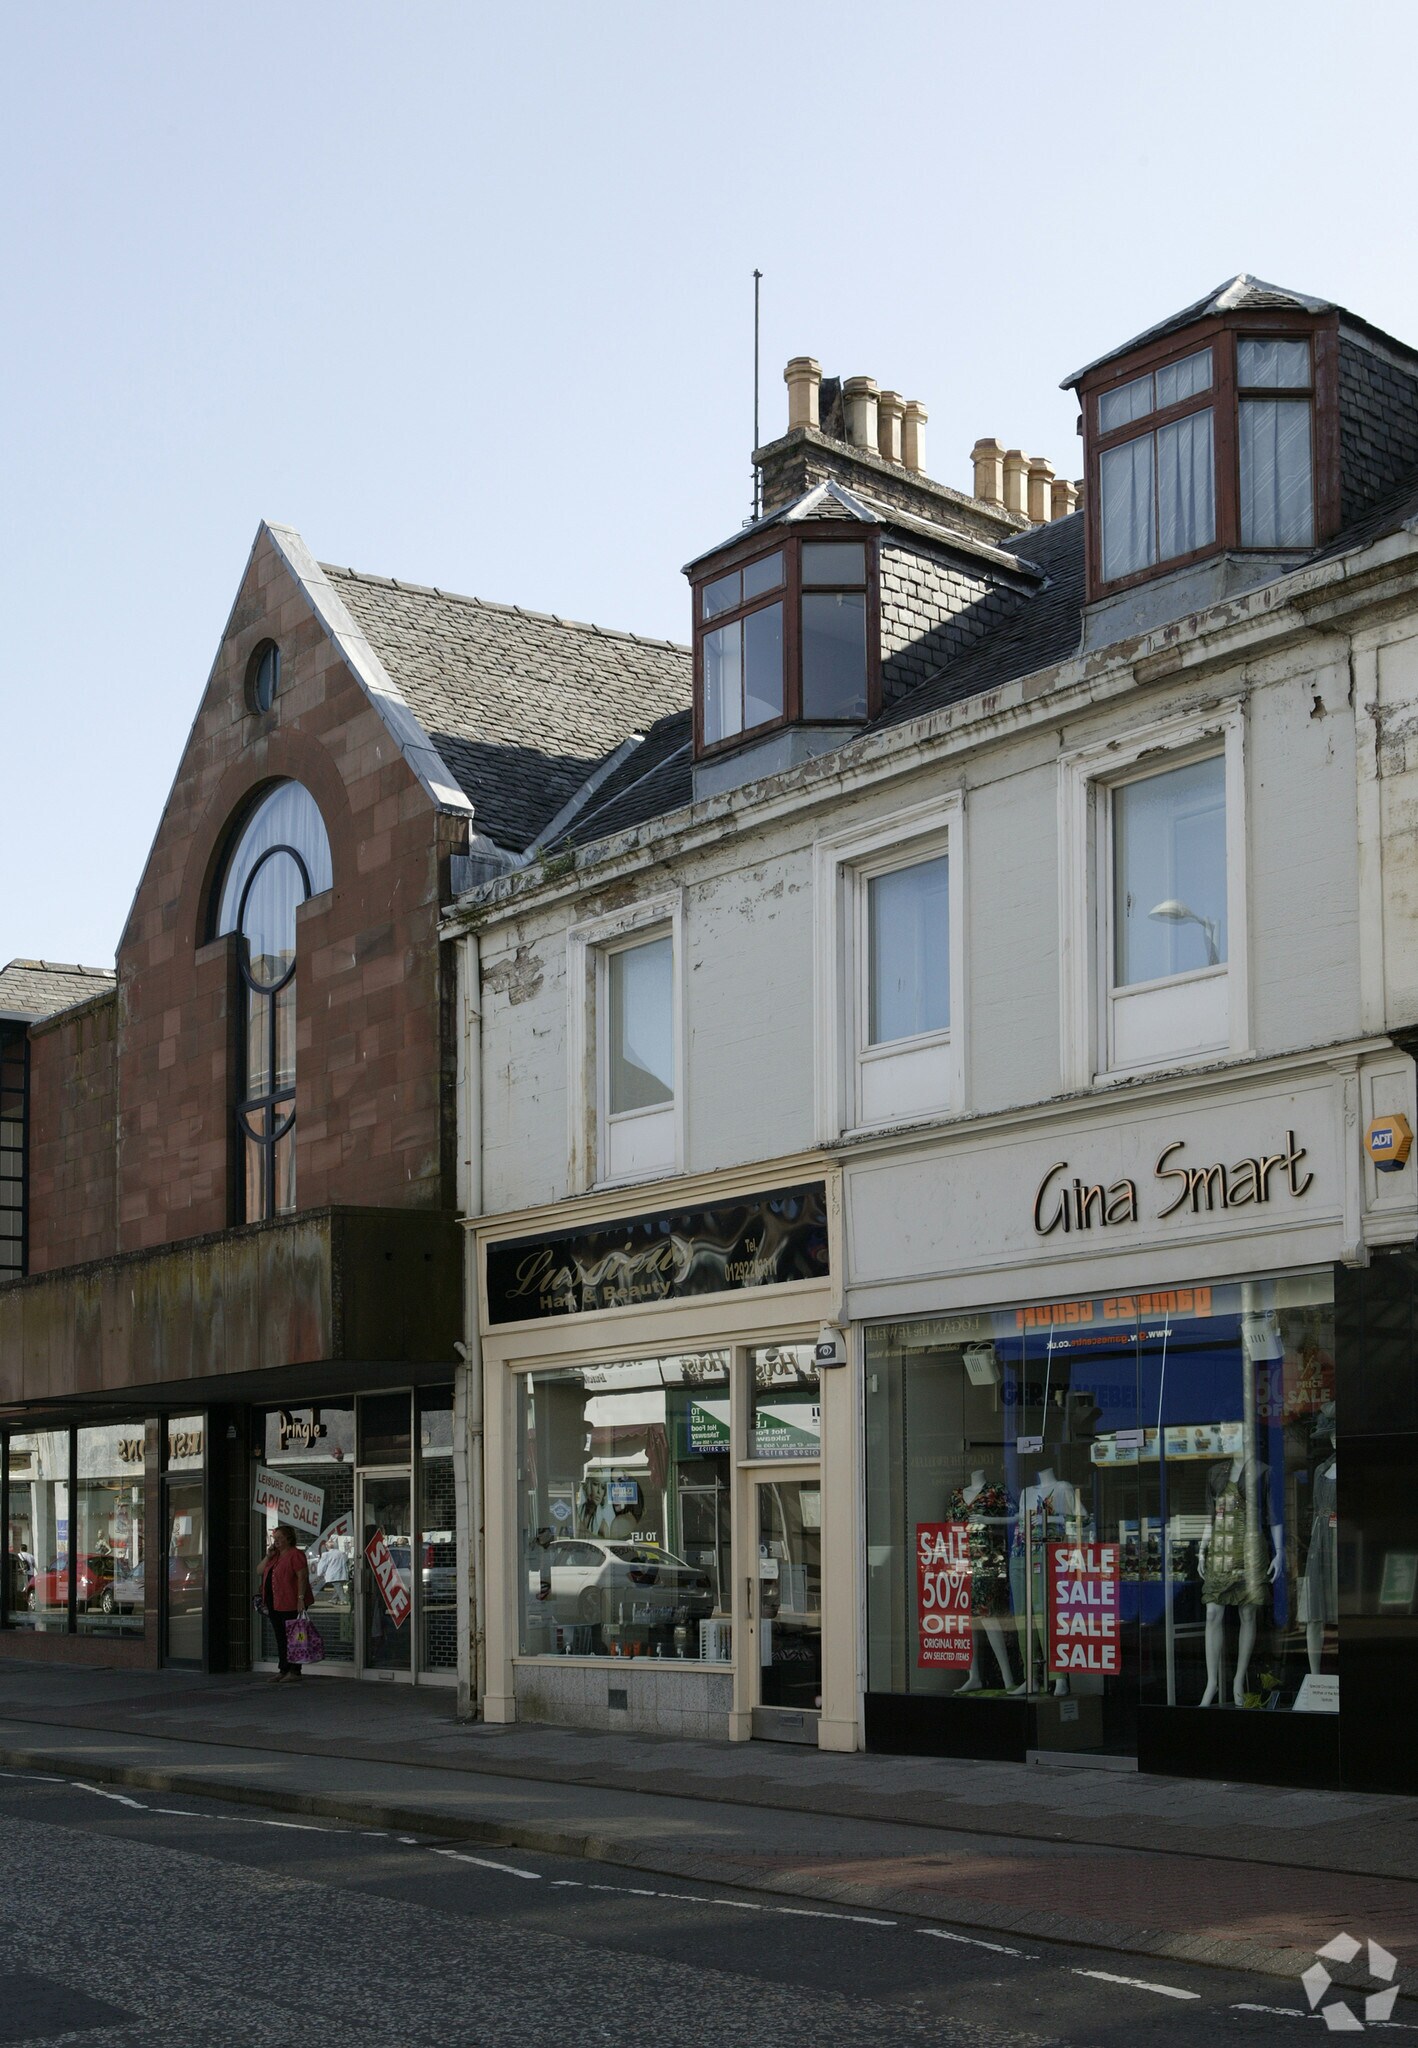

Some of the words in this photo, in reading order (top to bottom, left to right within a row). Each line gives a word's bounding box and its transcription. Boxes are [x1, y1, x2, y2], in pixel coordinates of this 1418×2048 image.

[1372, 1132, 1393, 1147] ADT
[1033, 1161, 1137, 1236] Gina
[1153, 1130, 1314, 1219] Smart
[505, 1238, 694, 1298] Luscious
[540, 1293, 578, 1310] Hair
[583, 1287, 597, 1303] &
[603, 1281, 672, 1301] Beauty
[1288, 1389, 1330, 1404] SALE
[1296, 1380, 1323, 1389] PRICE
[279, 1409, 322, 1450] Pringle
[258, 1473, 284, 1491] LEISURE
[284, 1484, 302, 1498] GOLF
[303, 1491, 321, 1507] WEAR
[256, 1490, 291, 1516] LADIES
[292, 1504, 319, 1528] SALE
[920, 1531, 969, 1565] SALE
[1055, 1549, 1115, 1573] SALE
[370, 1541, 408, 1618] SALE
[922, 1571, 969, 1609] 50%
[1055, 1580, 1115, 1605] SALE
[922, 1614, 969, 1634] OFF
[1055, 1612, 1115, 1637] SALE
[923, 1638, 953, 1649] ORIGINAL
[953, 1639, 971, 1650] PRICE
[923, 1651, 933, 1660] ON
[933, 1652, 955, 1661] SELECTED
[955, 1653, 969, 1661] ITEMS
[1055, 1643, 1115, 1669] SALE
